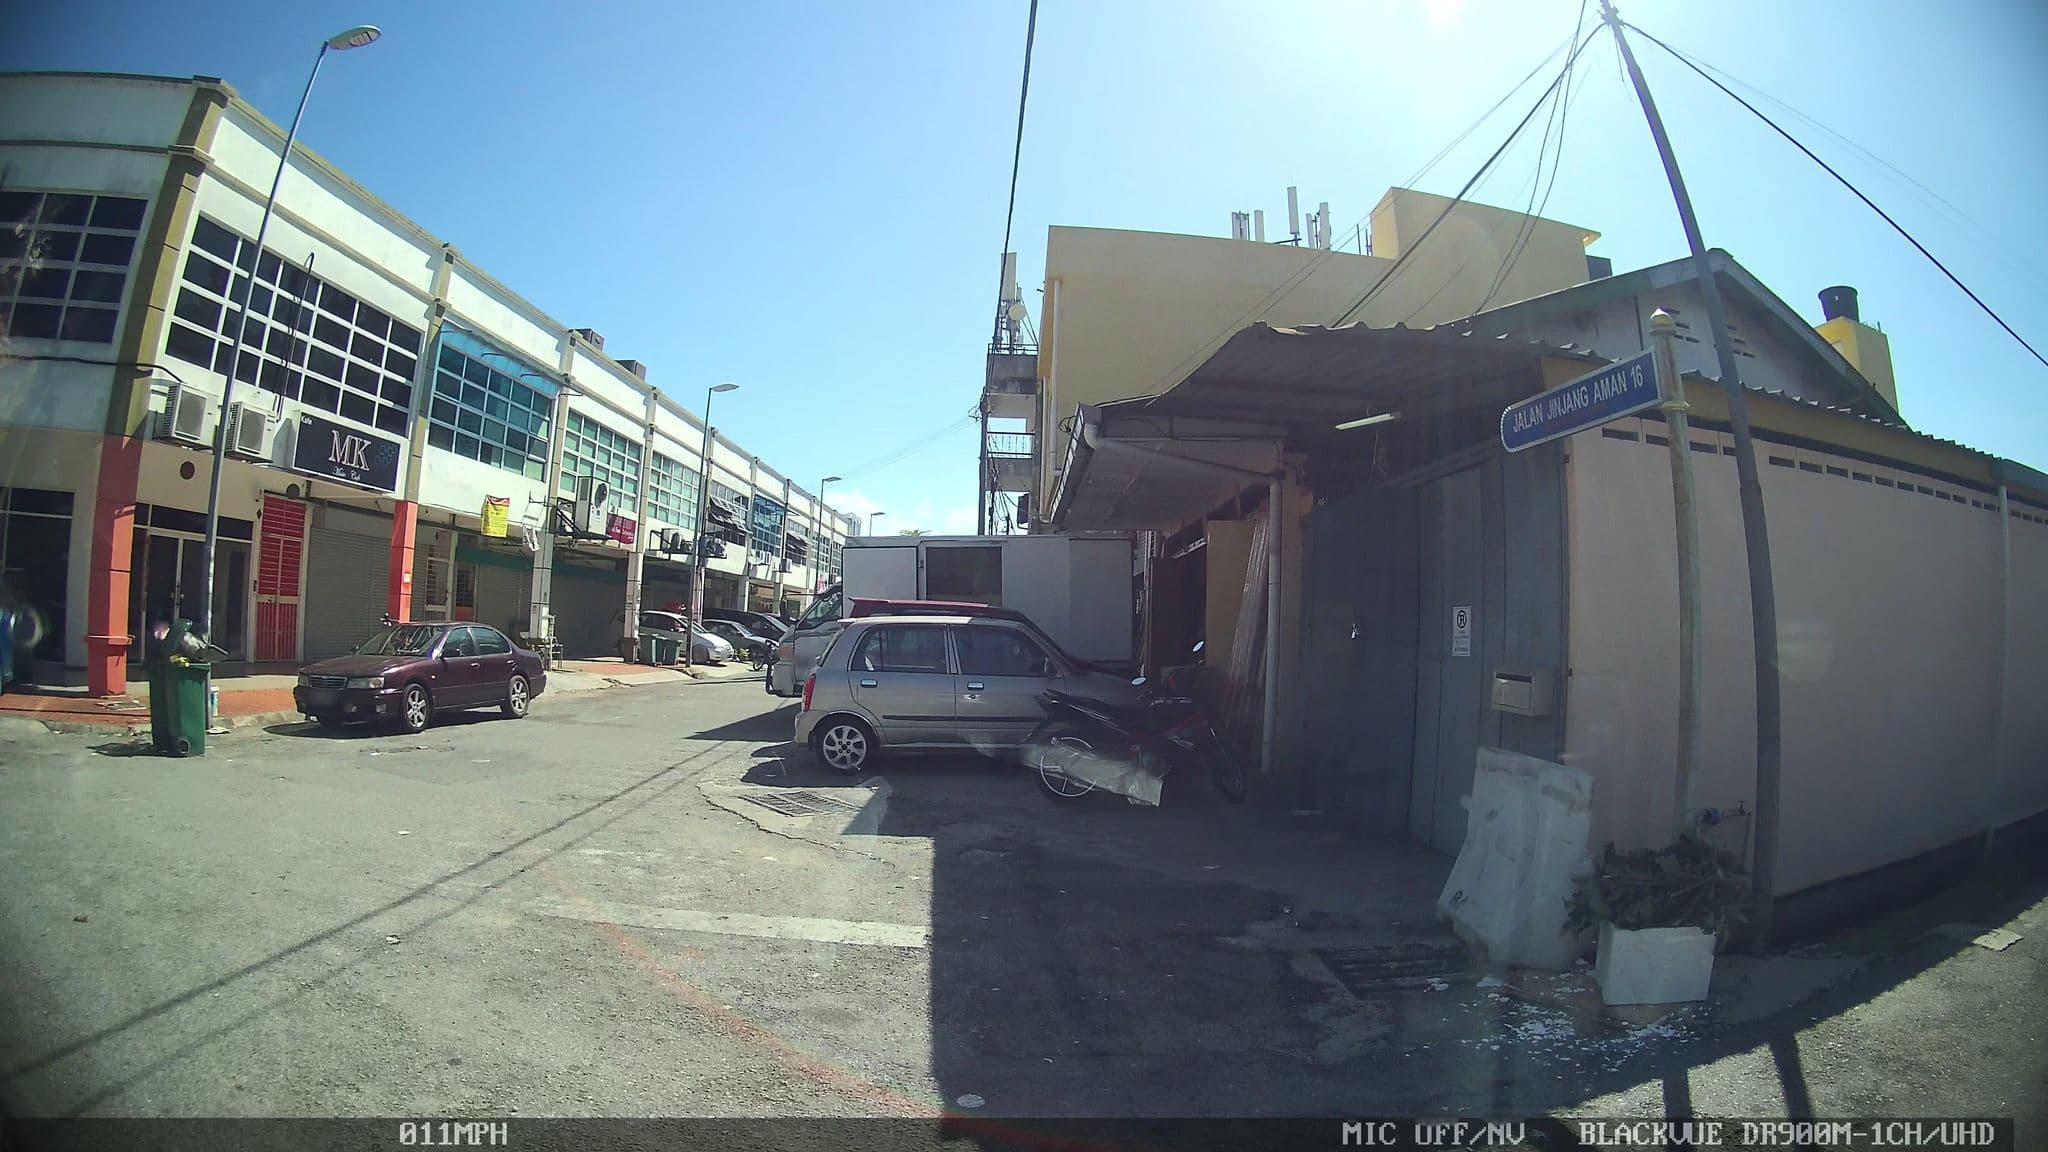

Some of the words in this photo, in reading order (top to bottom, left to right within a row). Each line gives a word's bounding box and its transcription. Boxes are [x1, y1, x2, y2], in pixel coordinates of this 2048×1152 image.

[1512, 404, 1544, 433] JALAN
[1547, 386, 1590, 419] JINJANG
[1593, 371, 1628, 404] AMAN
[1630, 364, 1644, 389] 16
[328, 429, 372, 471] MK
